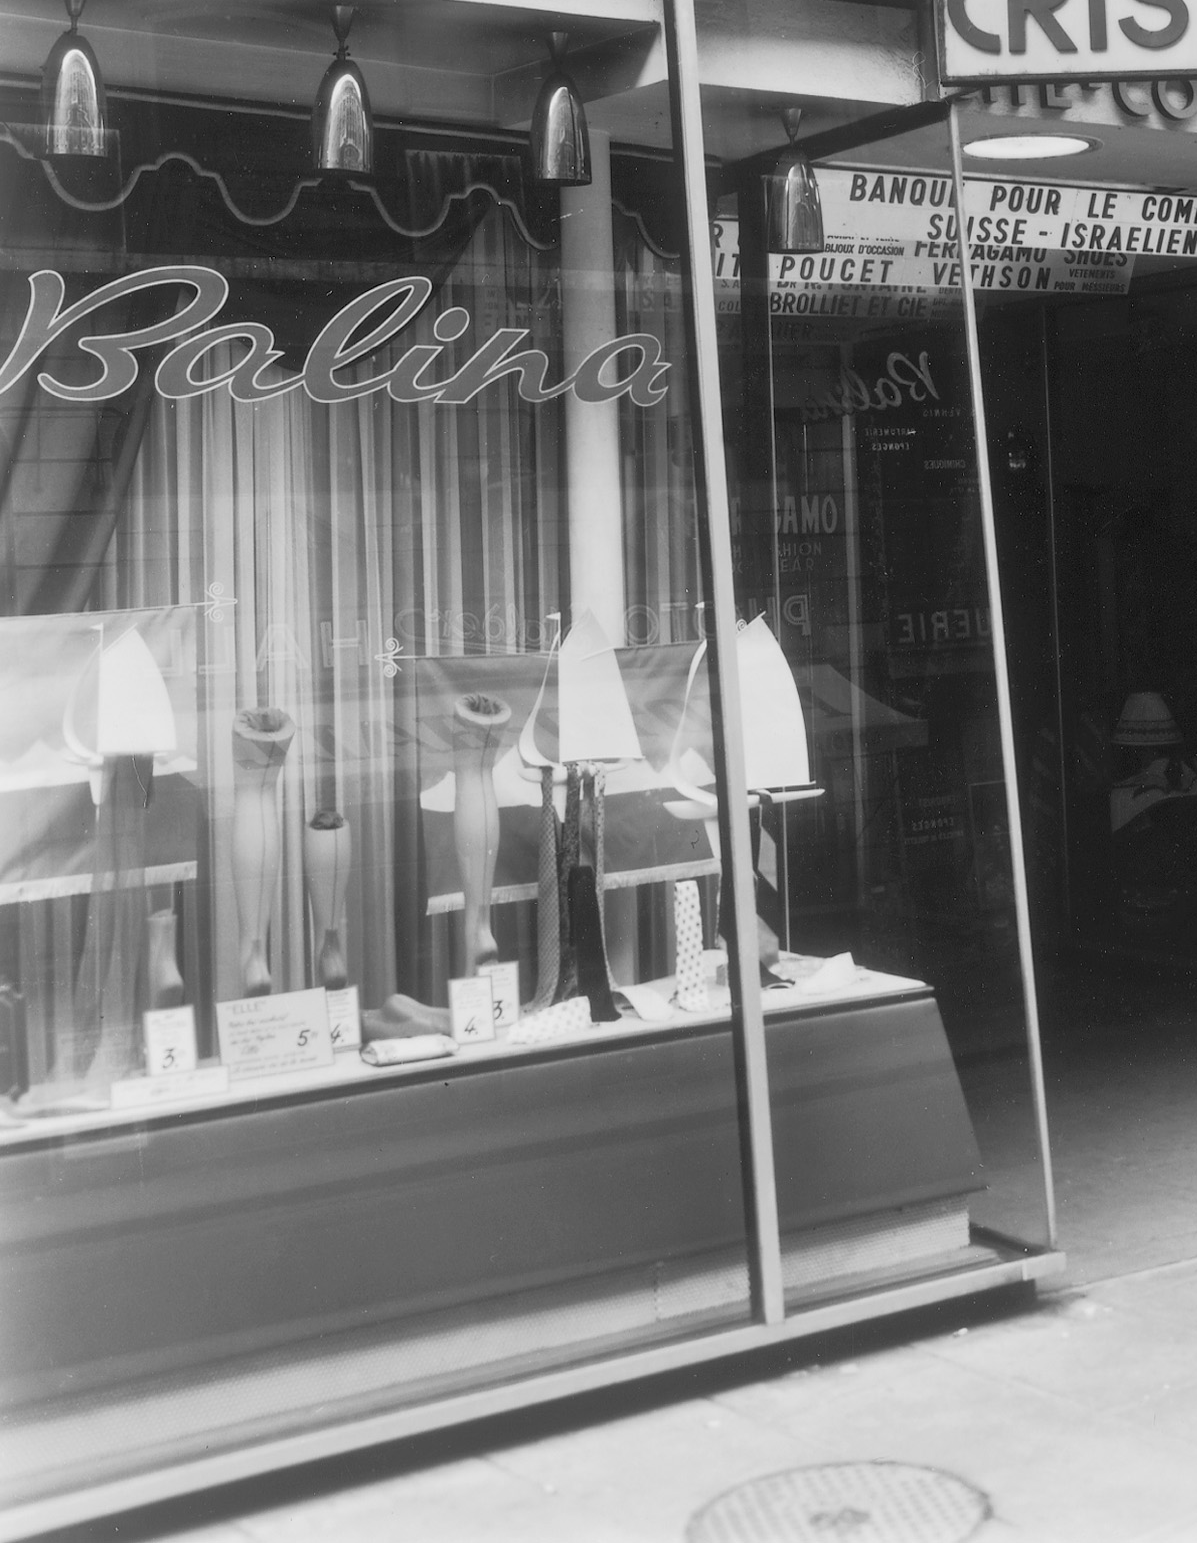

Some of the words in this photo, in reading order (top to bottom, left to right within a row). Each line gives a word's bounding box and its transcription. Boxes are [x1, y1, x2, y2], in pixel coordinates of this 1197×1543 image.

[990, 185, 1063, 215] POUR
[1088, 193, 1118, 219] LE
[824, 243, 855, 255] BIJOUX
[779, 256, 894, 284] POUCET
[1054, 280, 1076, 292] POUR
[770, 291, 859, 315] BROLLIET
[867, 294, 889, 317] ET
[897, 295, 929, 318] CIE
[0, 264, 672, 407] Balina
